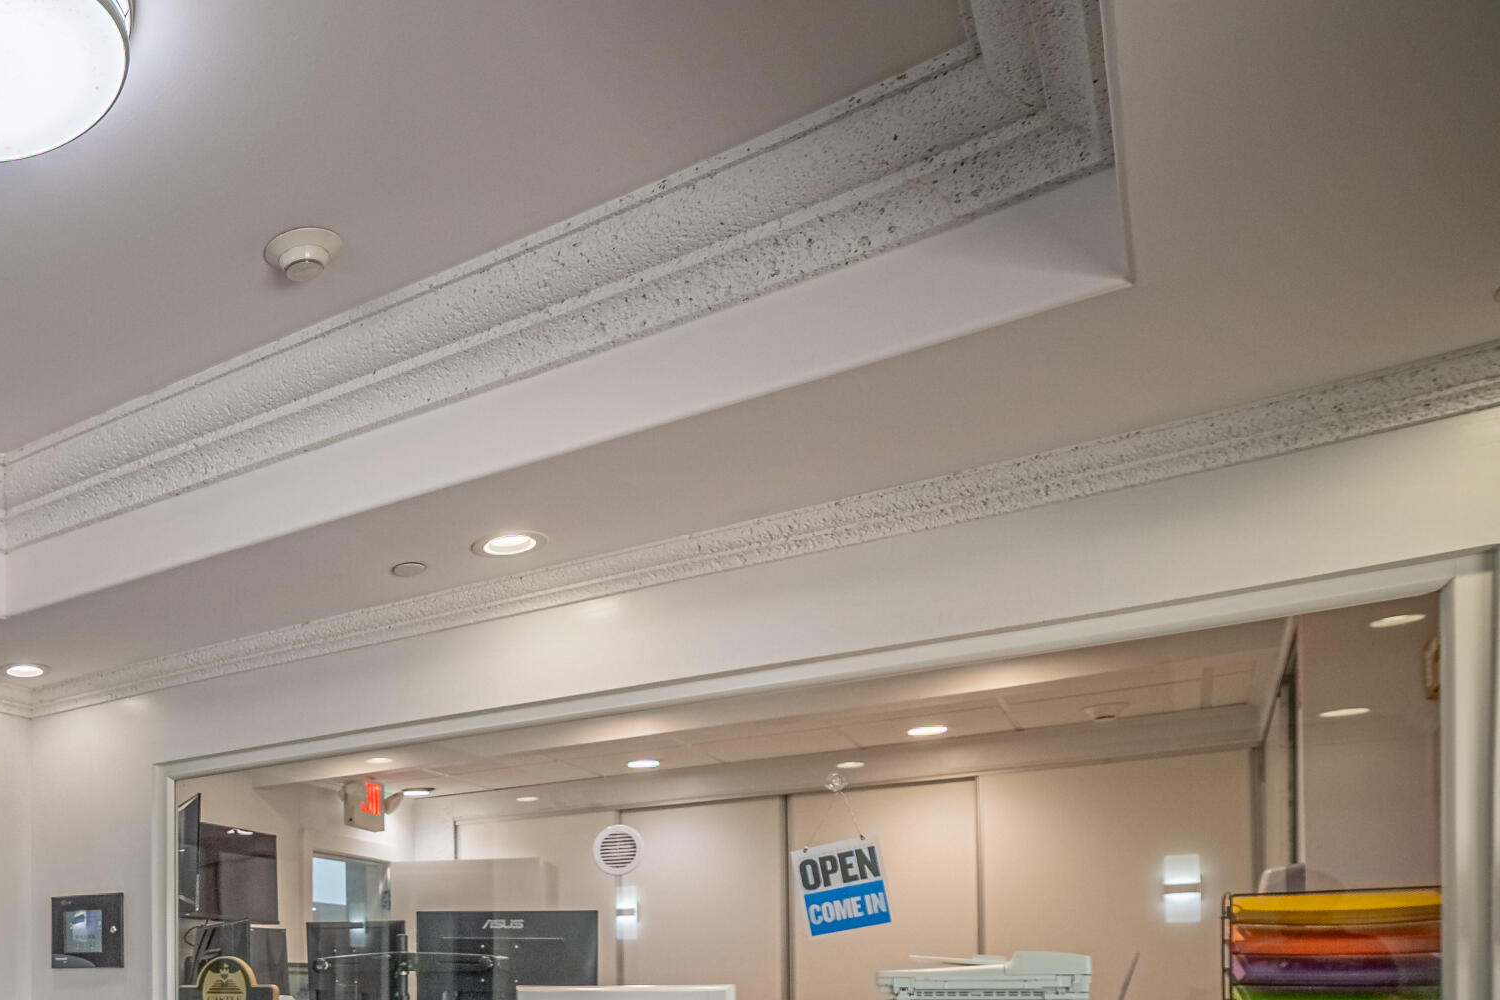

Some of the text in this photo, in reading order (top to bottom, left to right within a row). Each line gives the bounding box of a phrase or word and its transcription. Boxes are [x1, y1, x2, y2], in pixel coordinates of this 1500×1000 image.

[799, 845, 881, 891] OPEN
[482, 919, 525, 929] ASUS
[808, 892, 887, 926] COME IN
